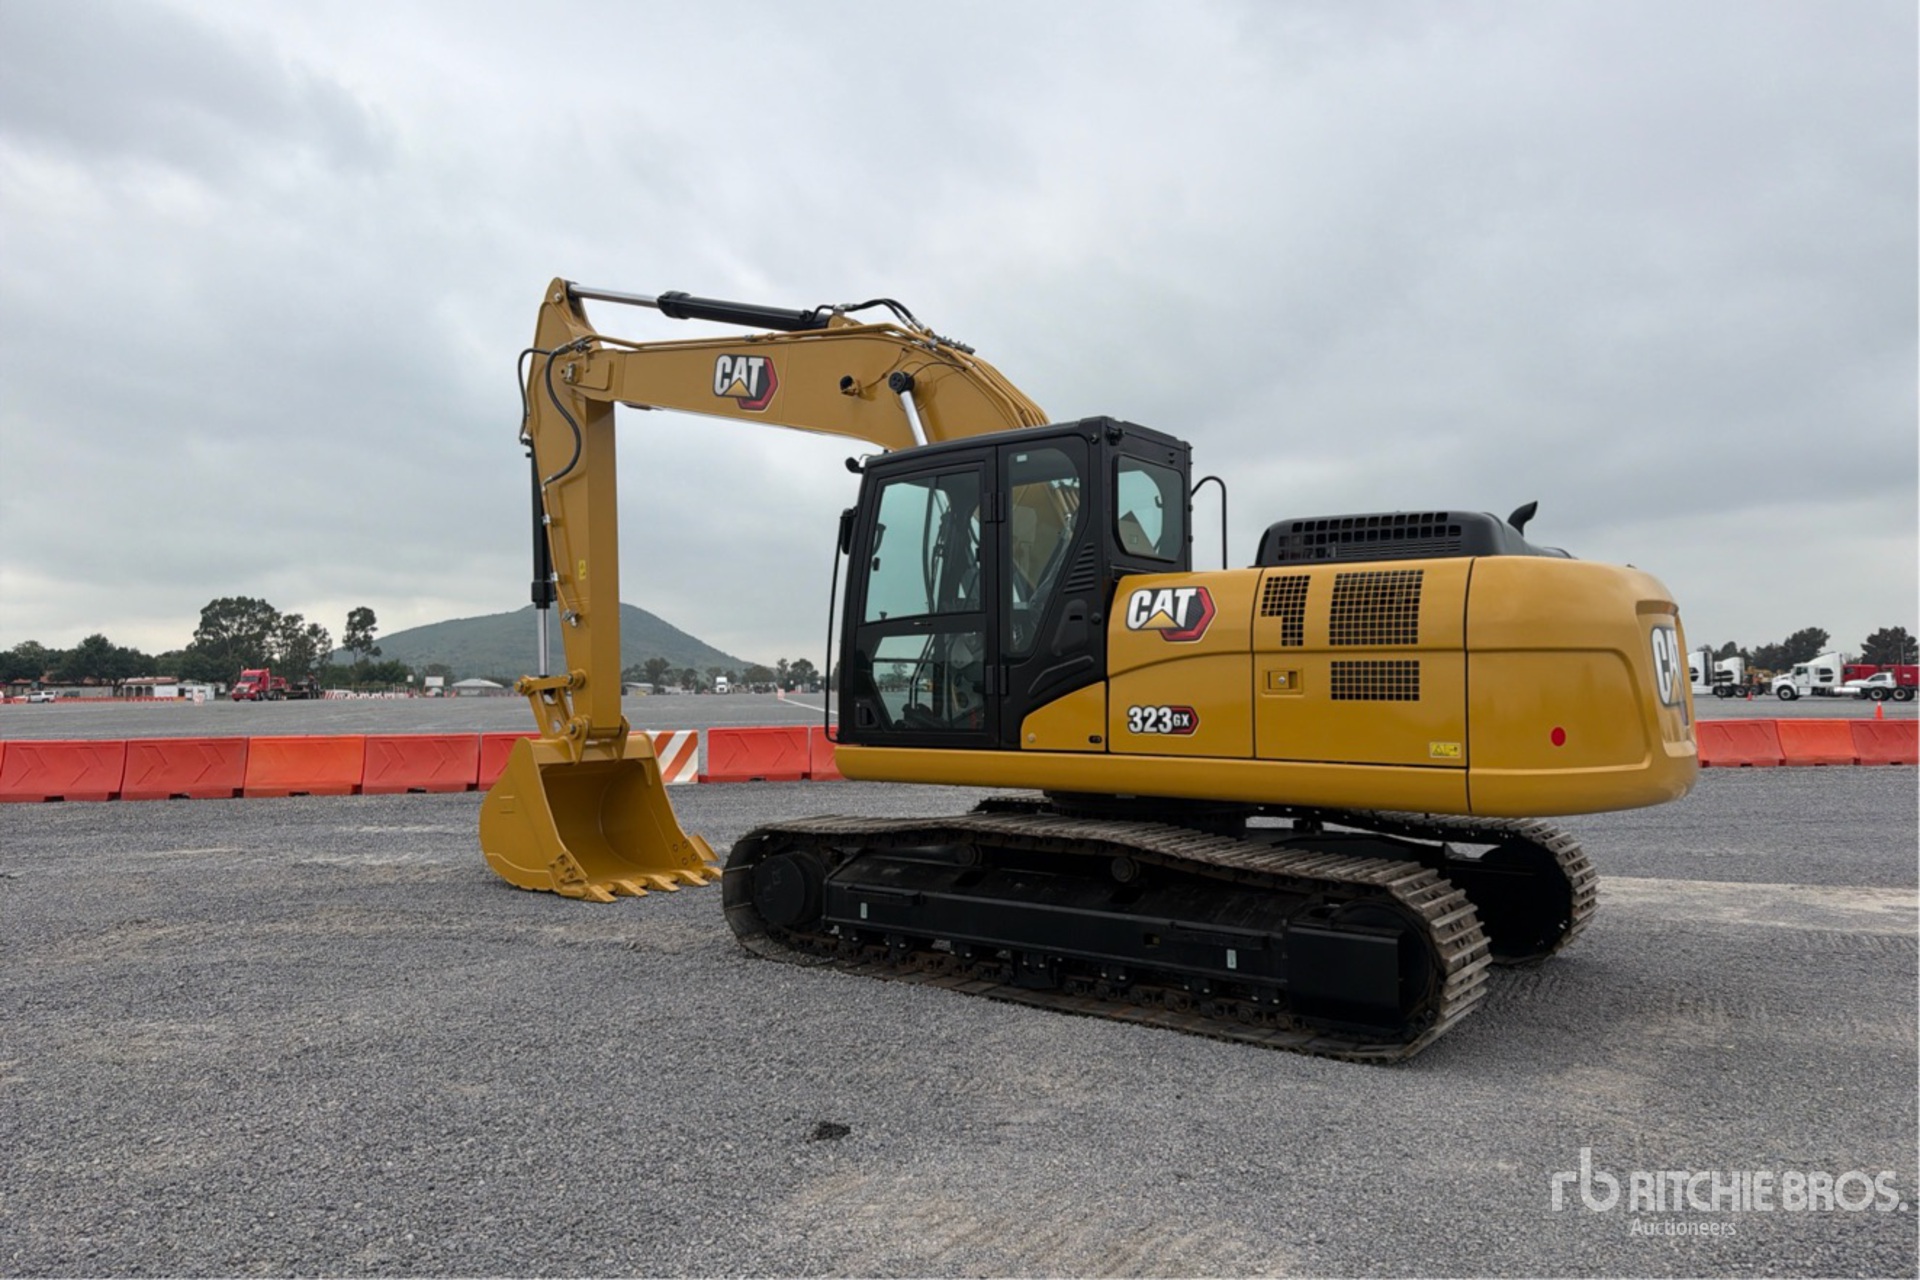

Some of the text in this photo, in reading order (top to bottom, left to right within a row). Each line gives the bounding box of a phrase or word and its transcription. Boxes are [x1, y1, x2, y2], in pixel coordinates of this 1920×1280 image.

[714, 355, 765, 397] CAT
[1127, 587, 1197, 629] CAT
[1652, 627, 1683, 704] CA
